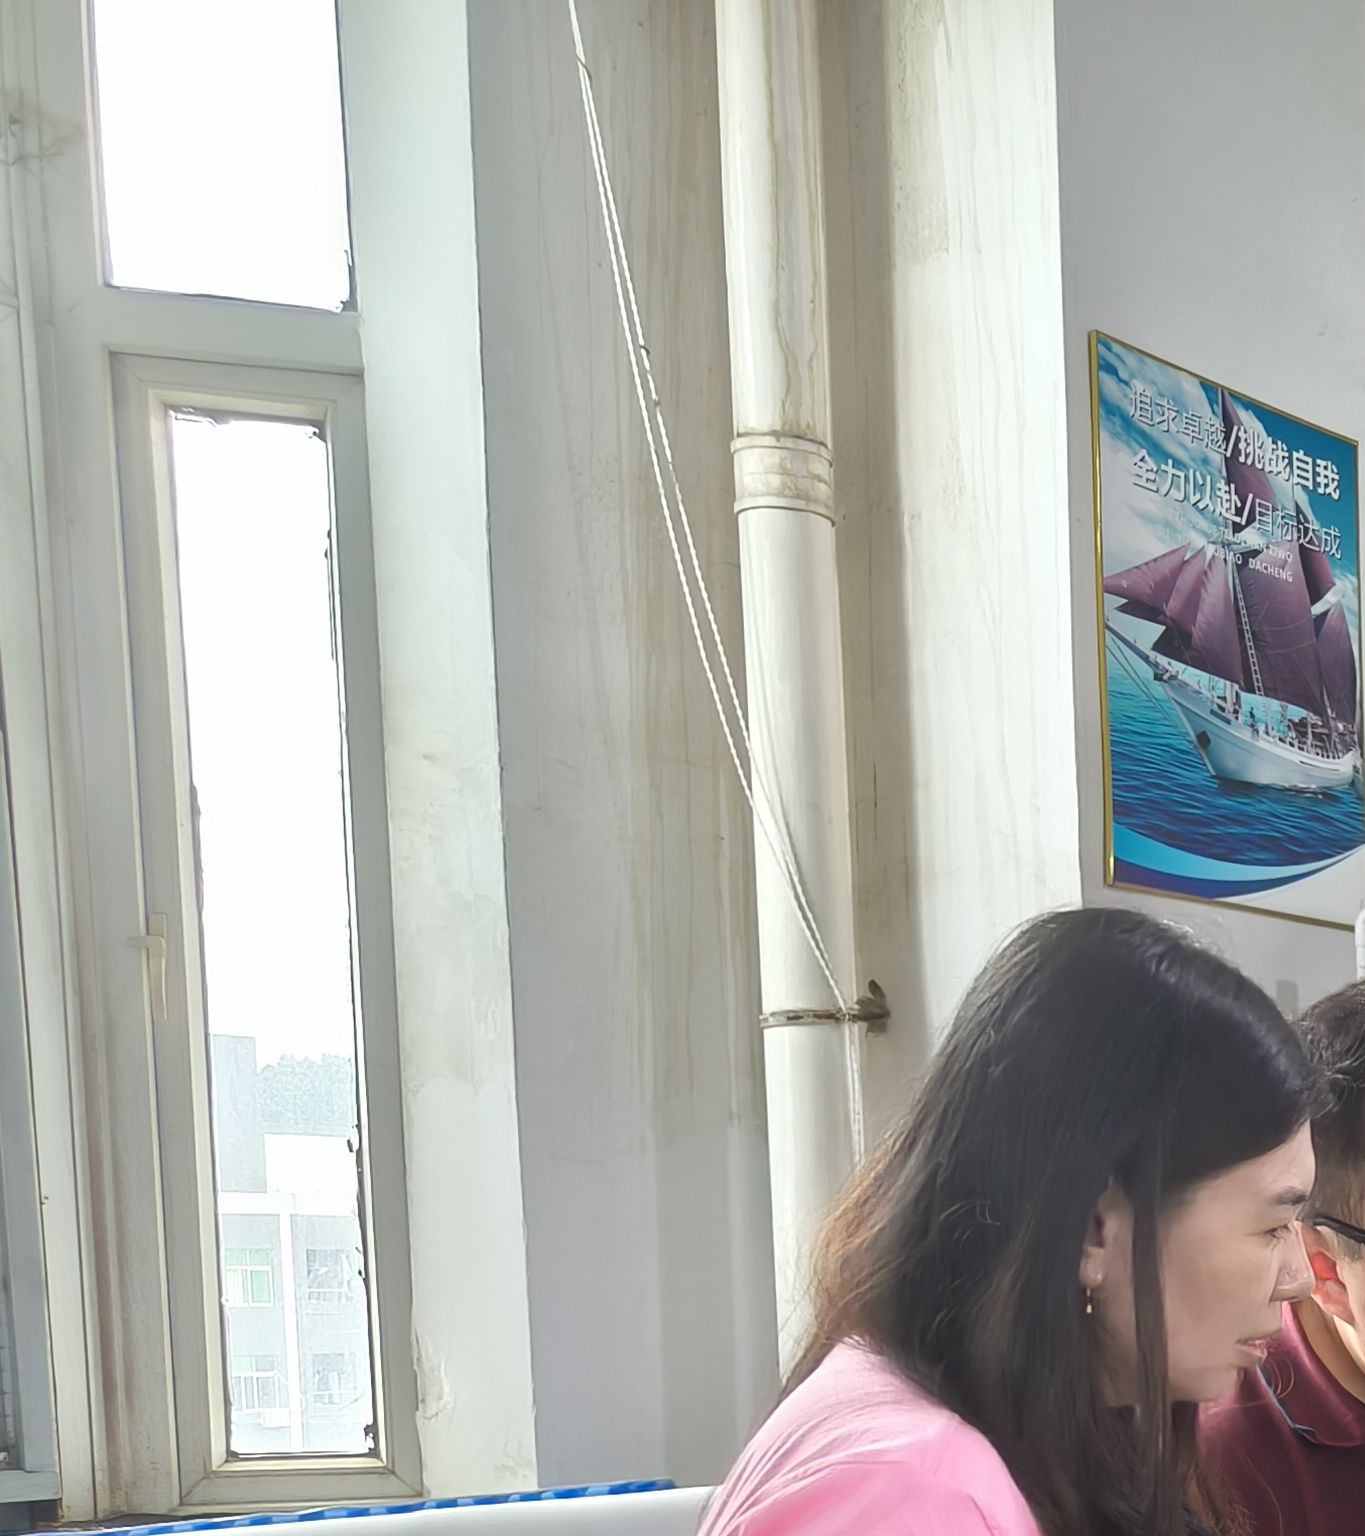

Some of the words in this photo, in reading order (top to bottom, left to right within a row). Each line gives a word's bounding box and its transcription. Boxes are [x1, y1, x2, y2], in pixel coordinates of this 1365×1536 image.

[1130, 381, 1340, 500] 追求卓越/挑战自我
[1132, 449, 1342, 559] 全力以赴/目标达成
[1248, 558, 1293, 582] DACHENG
